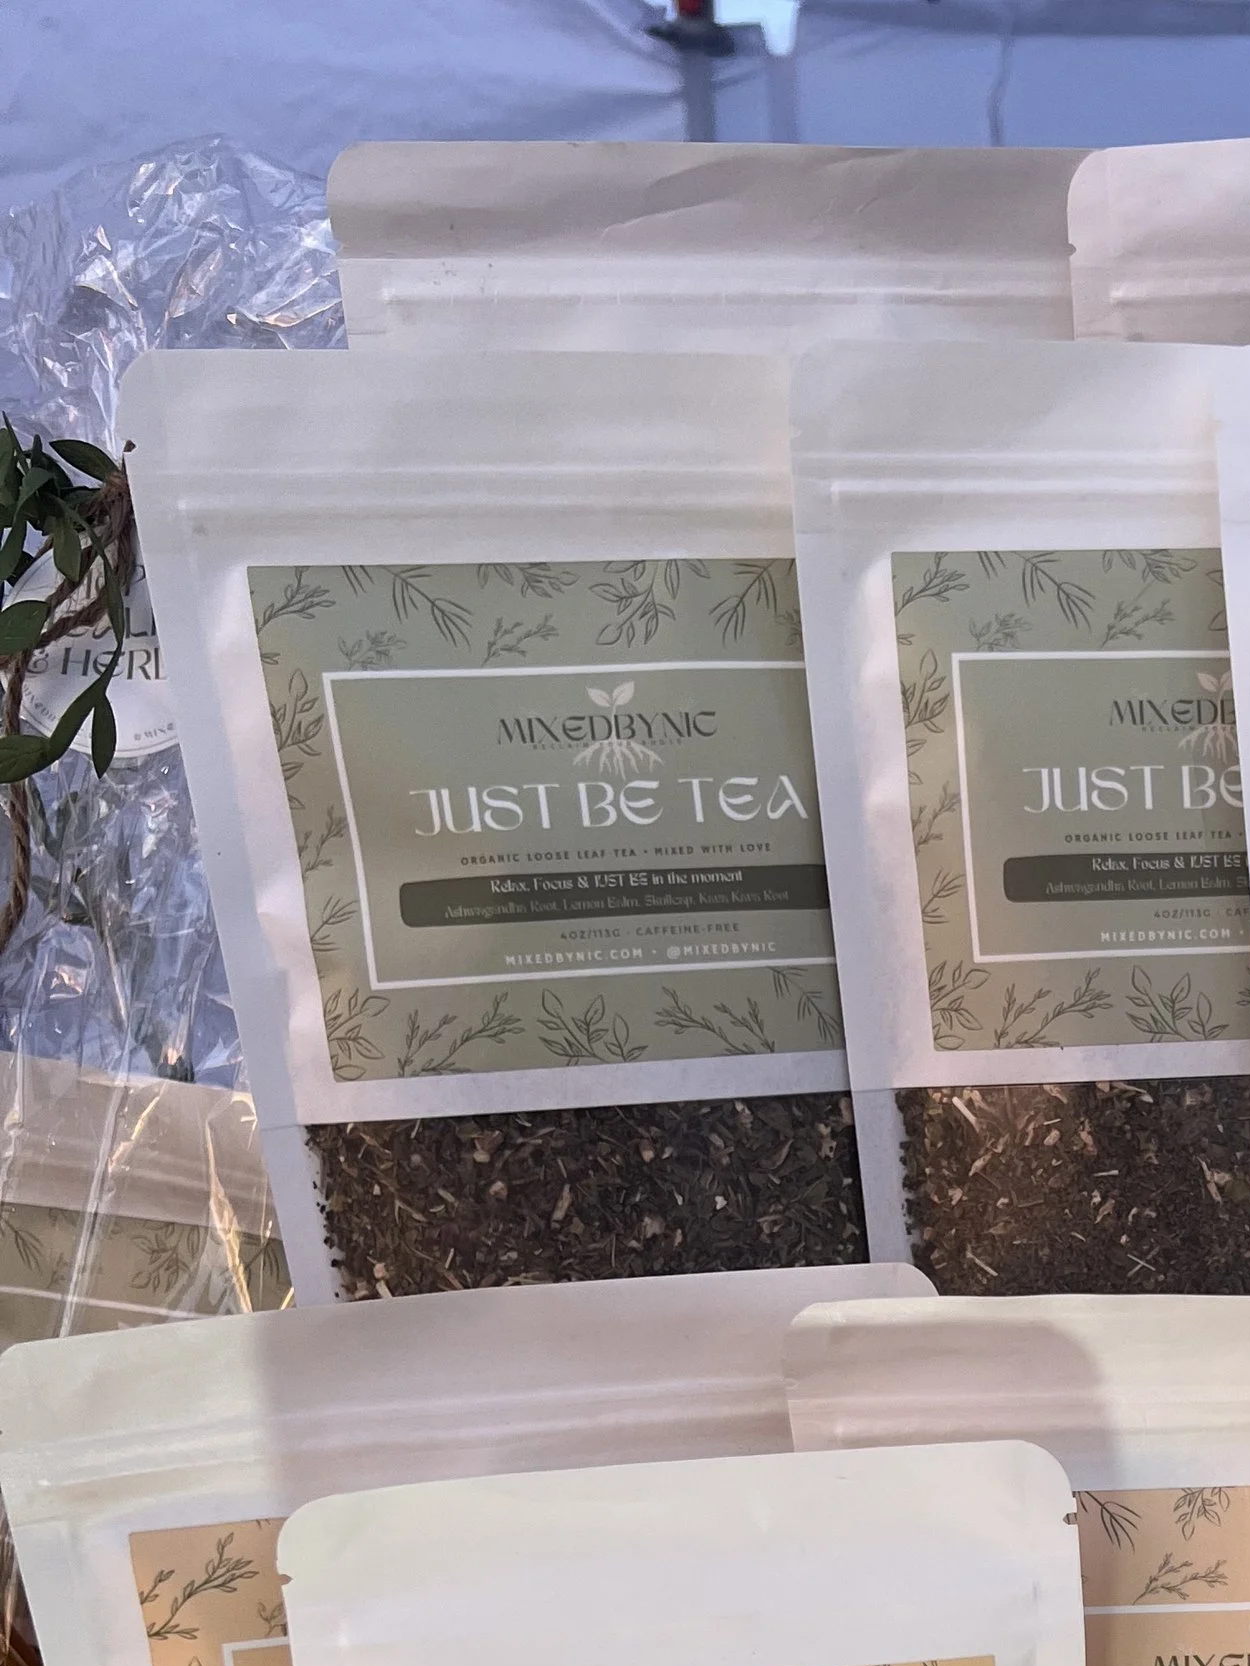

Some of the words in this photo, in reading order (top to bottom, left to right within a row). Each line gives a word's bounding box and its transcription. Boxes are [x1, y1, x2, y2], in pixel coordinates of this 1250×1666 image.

[498, 711, 718, 745] MIXEDBYNIC
[1022, 766, 1164, 813] JUST
[409, 783, 560, 836] JUST
[577, 780, 663, 828] BE
[677, 775, 809, 823] TEA
[1064, 832, 1121, 843] ORGANIC
[1129, 832, 1168, 842] LOOSE
[1176, 831, 1204, 840] LEAF
[1211, 830, 1232, 840] TEA
[461, 853, 520, 866] ORGANIC
[528, 851, 569, 862] LOOSE
[577, 850, 605, 860] LEAF
[614, 849, 636, 858] TEA
[655, 846, 694, 856] MIXED
[702, 844, 733, 854] WITH
[740, 843, 771, 852] LOVE
[1101, 928, 1231, 943] MIXEDBYNIC.COM
[505, 948, 643, 965] MIXEDBYNIC.COM
[667, 942, 776, 960] @MIXEDBYNIC
